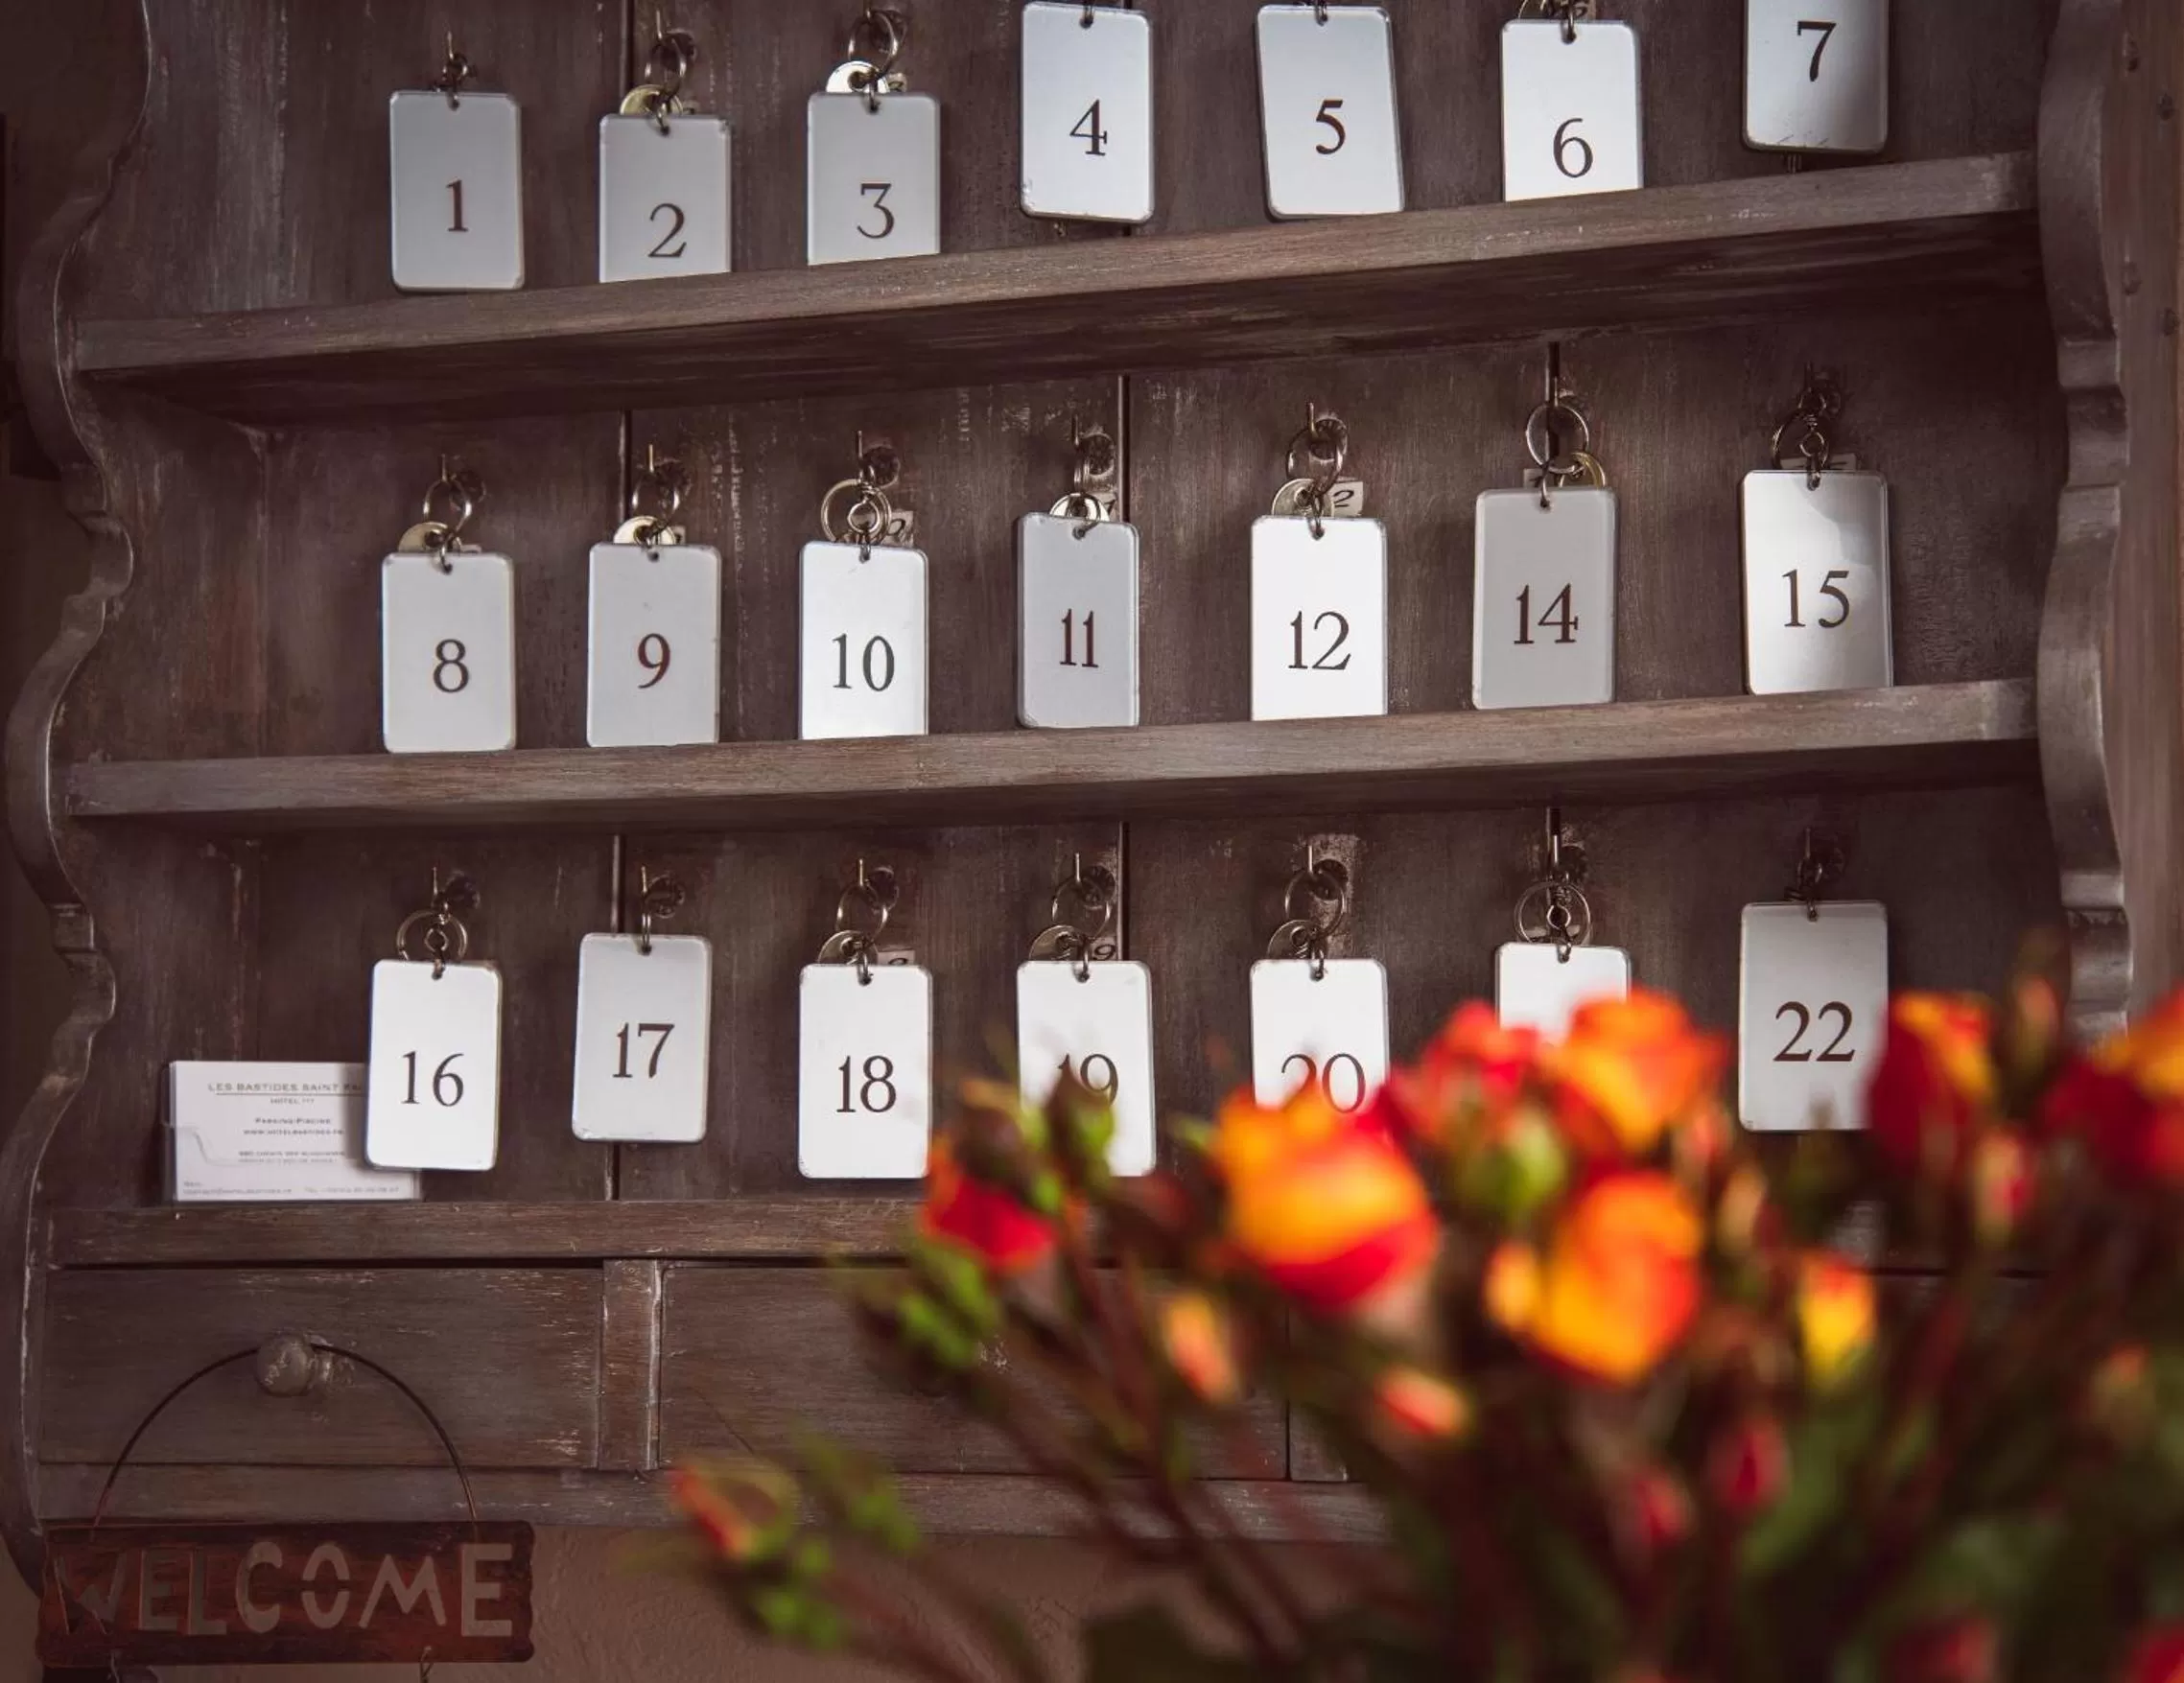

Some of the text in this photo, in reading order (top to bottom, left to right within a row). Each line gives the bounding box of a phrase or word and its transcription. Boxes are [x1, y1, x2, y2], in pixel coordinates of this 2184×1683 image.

[1797, 21, 1837, 82] 7
[1069, 100, 1107, 156] 4
[1316, 100, 1346, 154] 5
[1554, 118, 1593, 177] 6
[446, 179, 468, 232] 1
[648, 203, 687, 258] 2
[857, 183, 894, 239] 3
[1515, 583, 1578, 644] 14
[1781, 569, 1851, 629] 15
[434, 639, 469, 693] 8
[638, 633, 670, 689] 9
[833, 634, 894, 691] 10
[1060, 609, 1098, 668] 11
[1288, 611, 1350, 670] 12
[613, 1023, 674, 1078] 17
[1773, 1001, 1855, 1062] 22
[207, 1083, 233, 1092] LES
[236, 1083, 298, 1092] BASTIDES
[403, 1051, 463, 1107] 16
[836, 1056, 896, 1112] 18
[1057, 1052, 1119, 1106] 9
[54, 1540, 513, 1637] WELCOME
